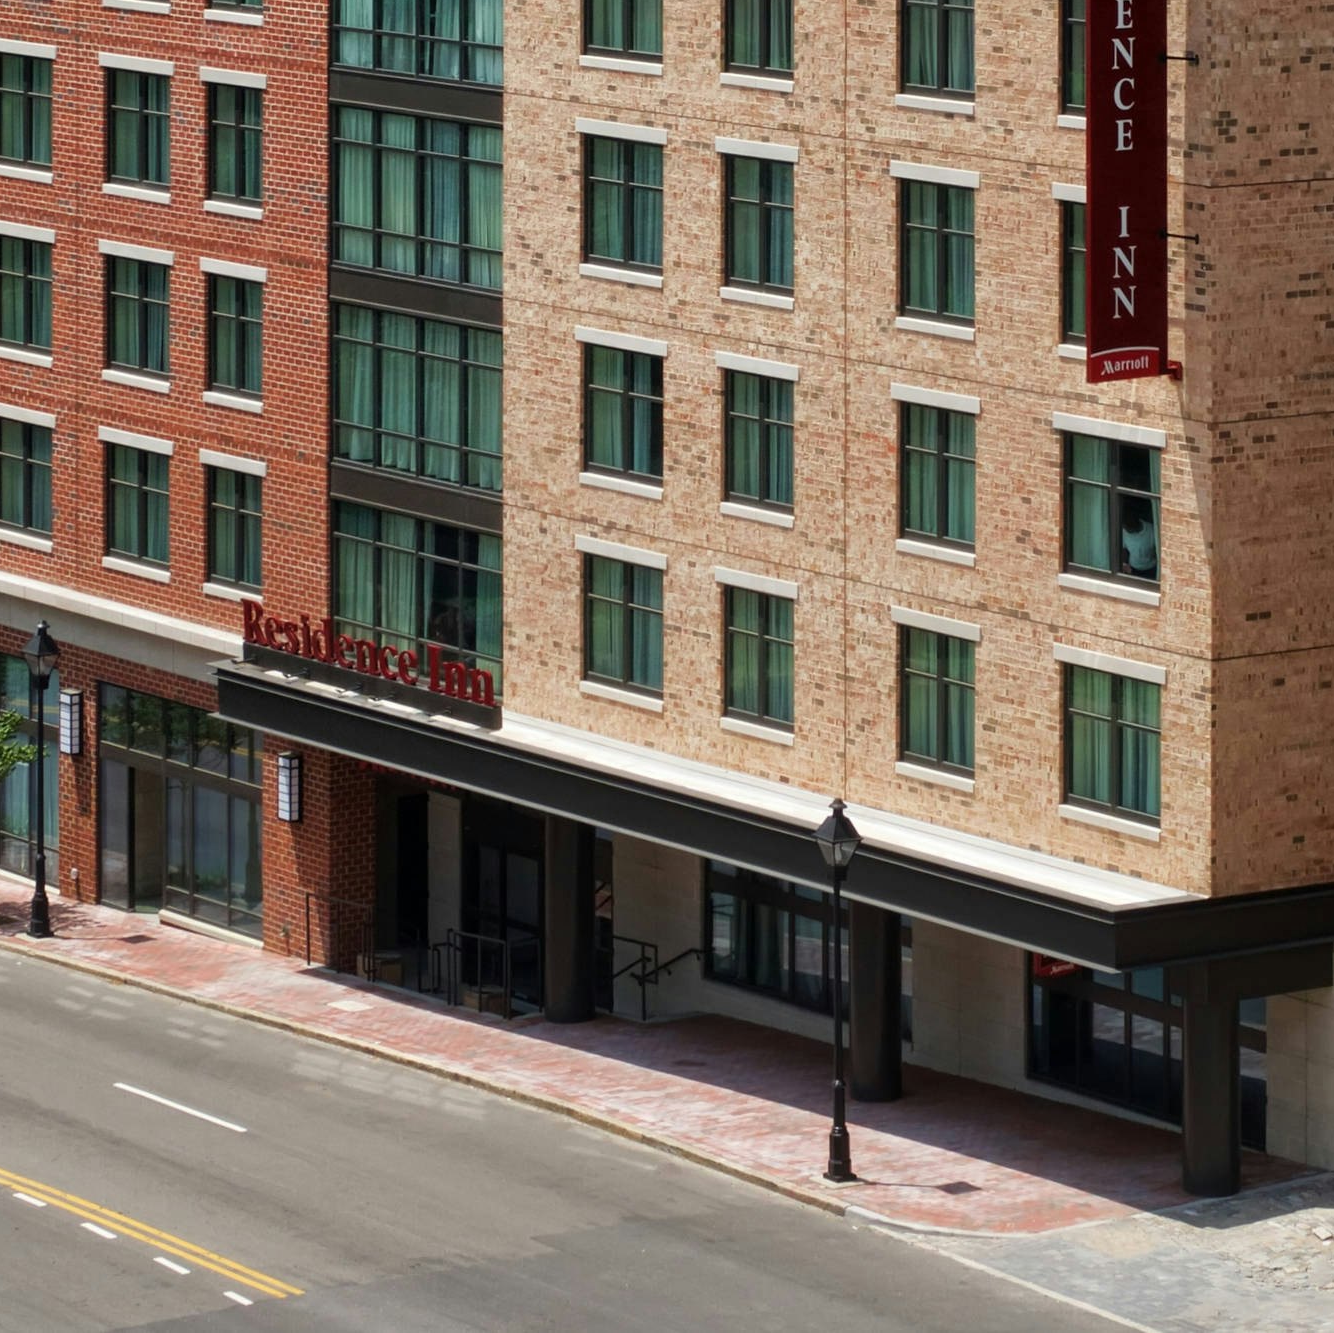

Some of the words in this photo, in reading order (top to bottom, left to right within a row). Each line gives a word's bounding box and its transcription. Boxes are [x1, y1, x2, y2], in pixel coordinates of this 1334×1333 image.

[1112, 206, 1137, 319] INN
[1100, 354, 1149, 376] Marriott
[242, 598, 417, 685] Residence
[426, 643, 498, 707] Inn
